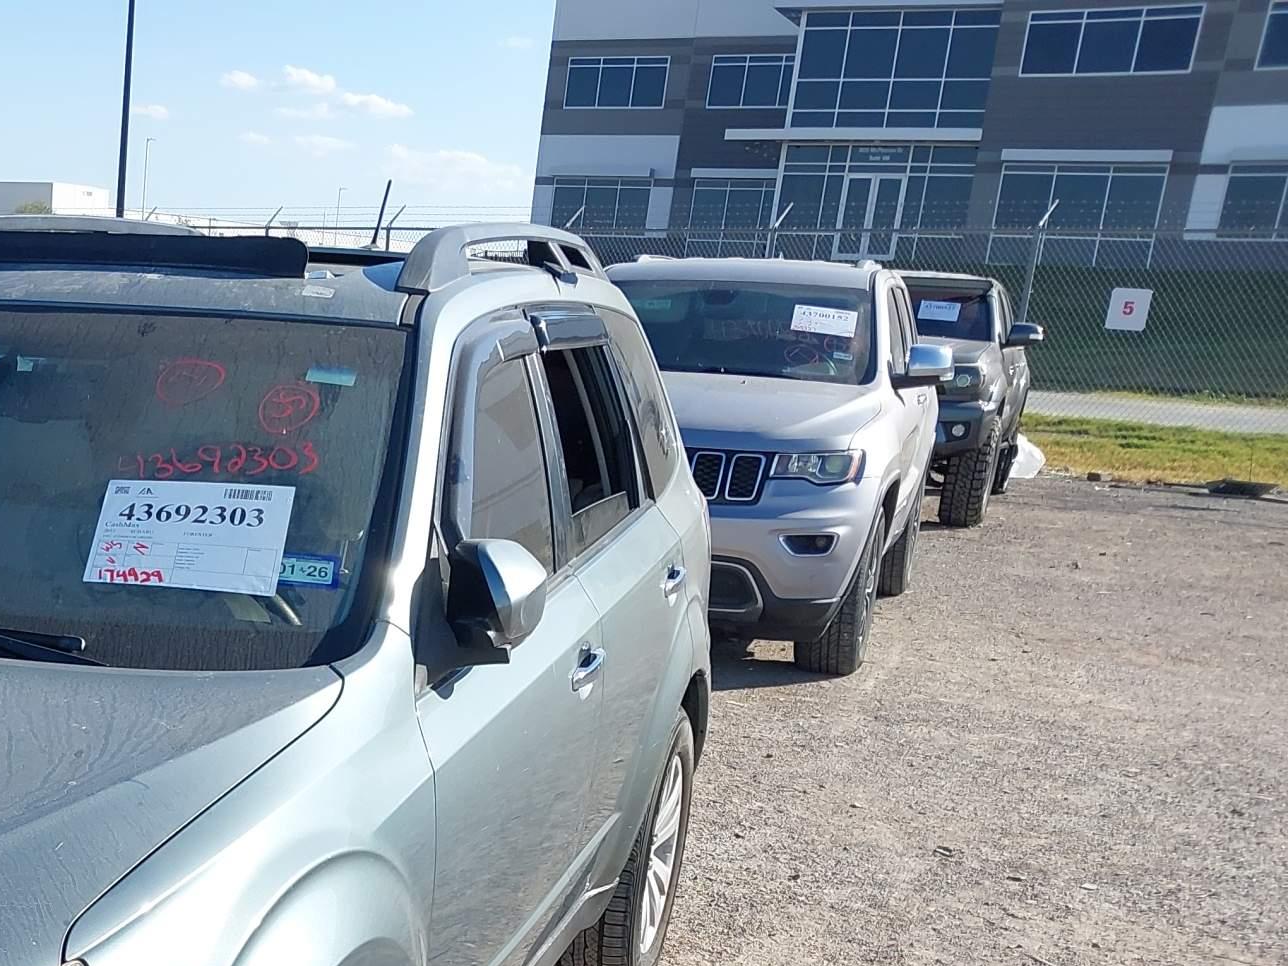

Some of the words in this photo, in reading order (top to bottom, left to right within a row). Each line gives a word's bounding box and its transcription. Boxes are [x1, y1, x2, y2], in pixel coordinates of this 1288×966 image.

[1122, 301, 1135, 316] 5
[118, 502, 265, 528] 43692303
[306, 564, 329, 579] 26
